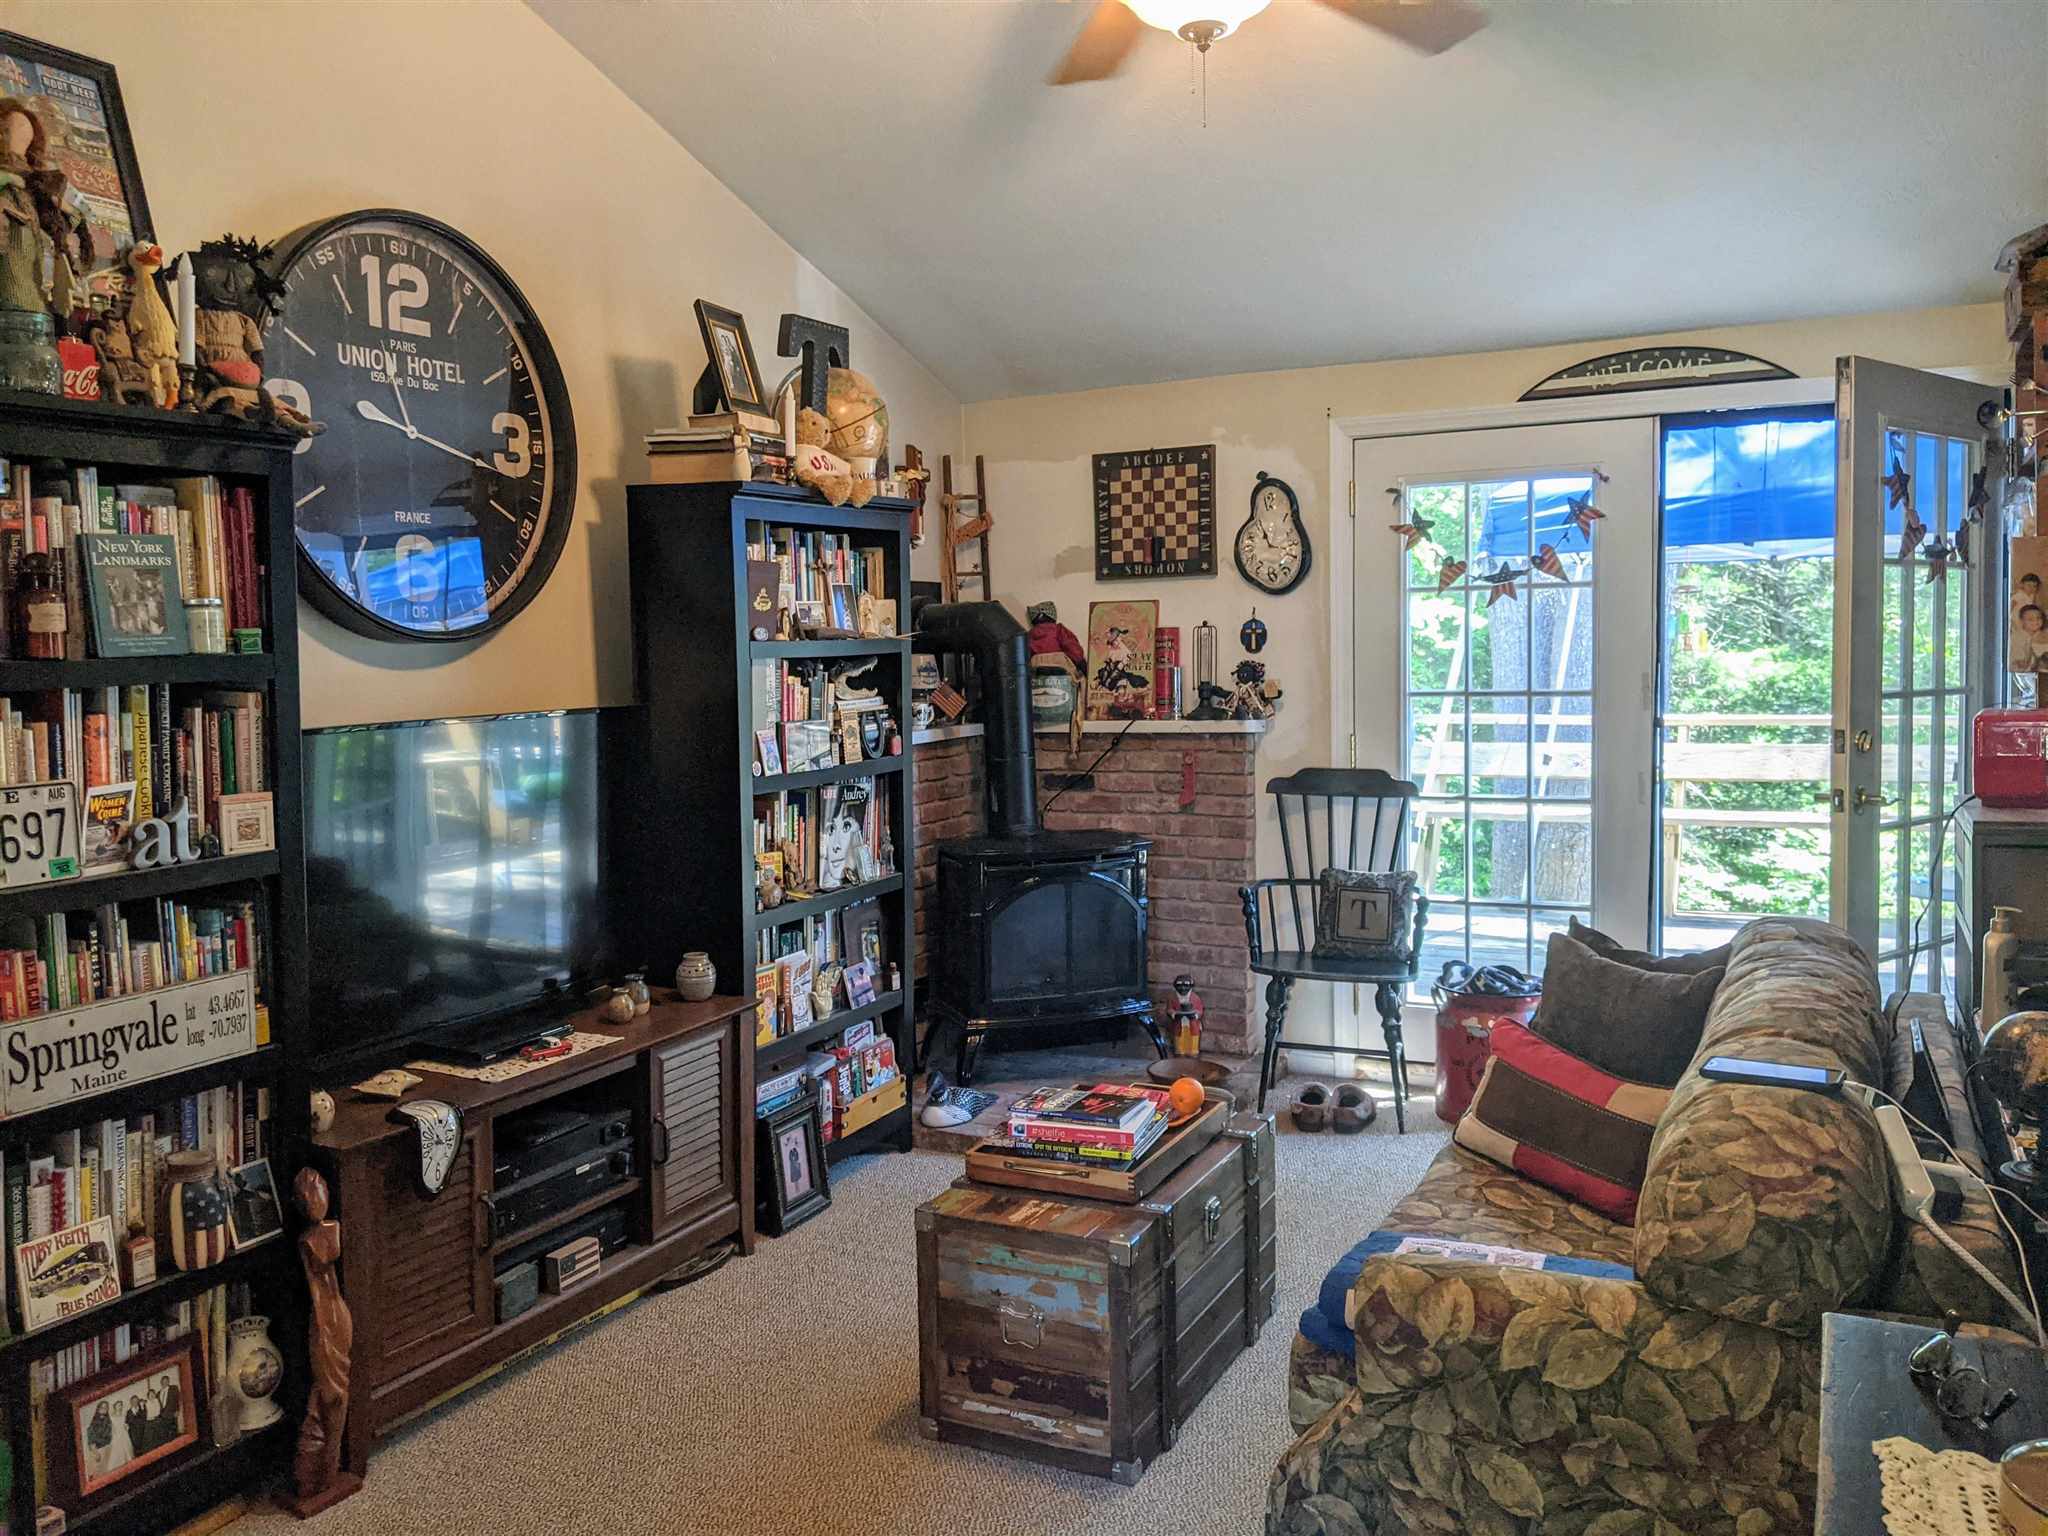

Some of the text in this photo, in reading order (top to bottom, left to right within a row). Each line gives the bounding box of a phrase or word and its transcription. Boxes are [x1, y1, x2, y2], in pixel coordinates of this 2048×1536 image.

[315, 247, 336, 266] 55
[360, 254, 431, 338] 12
[390, 339, 417, 354] PARIS
[337, 342, 466, 385] UNION HOTEL
[510, 352, 524, 371] 10
[1585, 357, 1713, 389] WELCOME
[407, 377, 420, 389] Du
[423, 380, 440, 392] Bac
[491, 411, 532, 479] 3
[532, 439, 543, 455] 15
[394, 510, 432, 524] FRANCE
[395, 533, 440, 603] 6
[135, 711, 151, 773] Japanese
[48, 787, 66, 800] AUG
[841, 786, 867, 802] Audrey
[0, 807, 66, 864] 697
[1350, 899, 1378, 930] T
[184, 989, 246, 1021] lat 43.4667
[186, 1013, 248, 1047] long -70.7937
[7, 1000, 179, 1093] Springvale
[71, 1068, 128, 1094] Maine
[1031, 1127, 1066, 1138] #shelfie
[54, 1225, 90, 1250] KEITH
